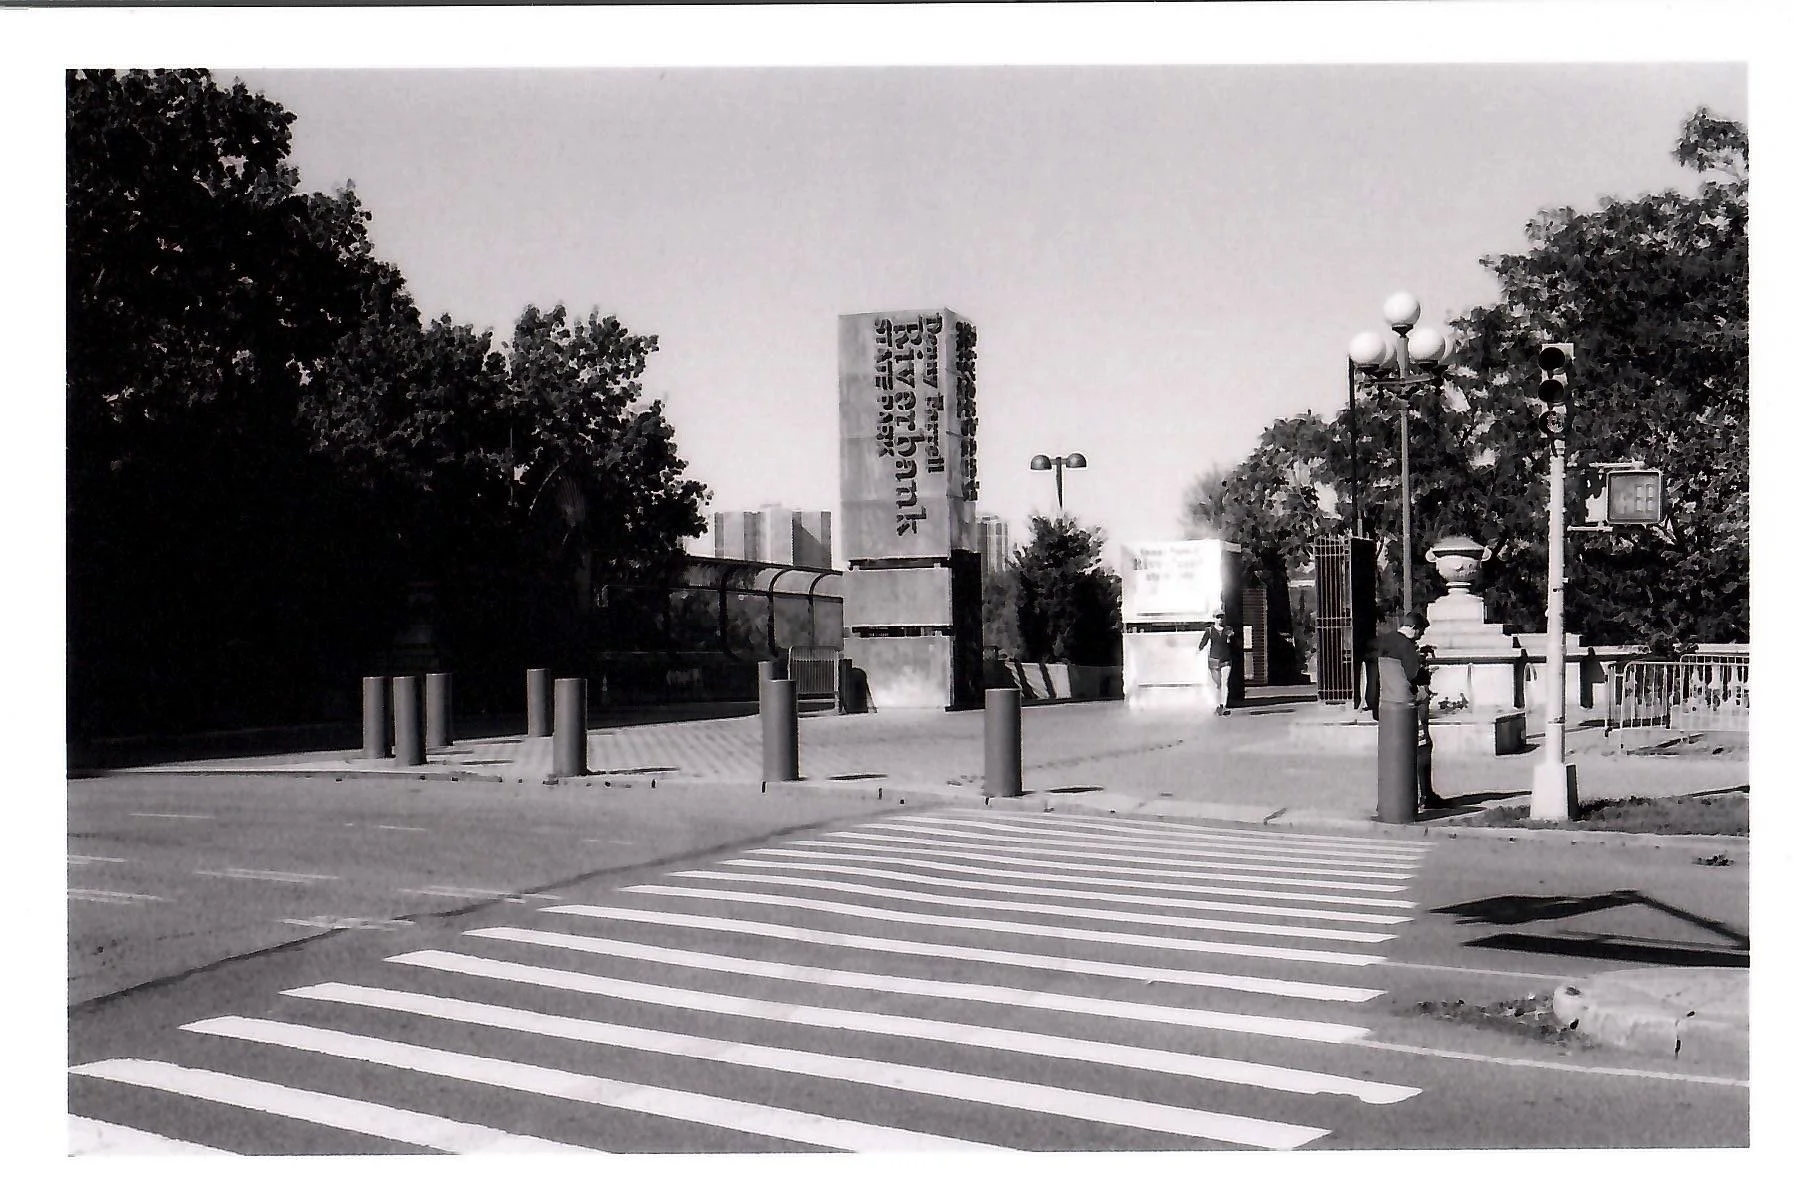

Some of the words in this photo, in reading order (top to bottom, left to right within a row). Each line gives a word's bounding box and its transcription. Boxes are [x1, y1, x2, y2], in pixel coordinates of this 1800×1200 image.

[874, 318, 893, 390] STATE
[923, 313, 943, 389] Denny
[876, 395, 894, 457] PARK
[893, 315, 926, 536] Riverbank
[925, 393, 944, 473] Farrell
